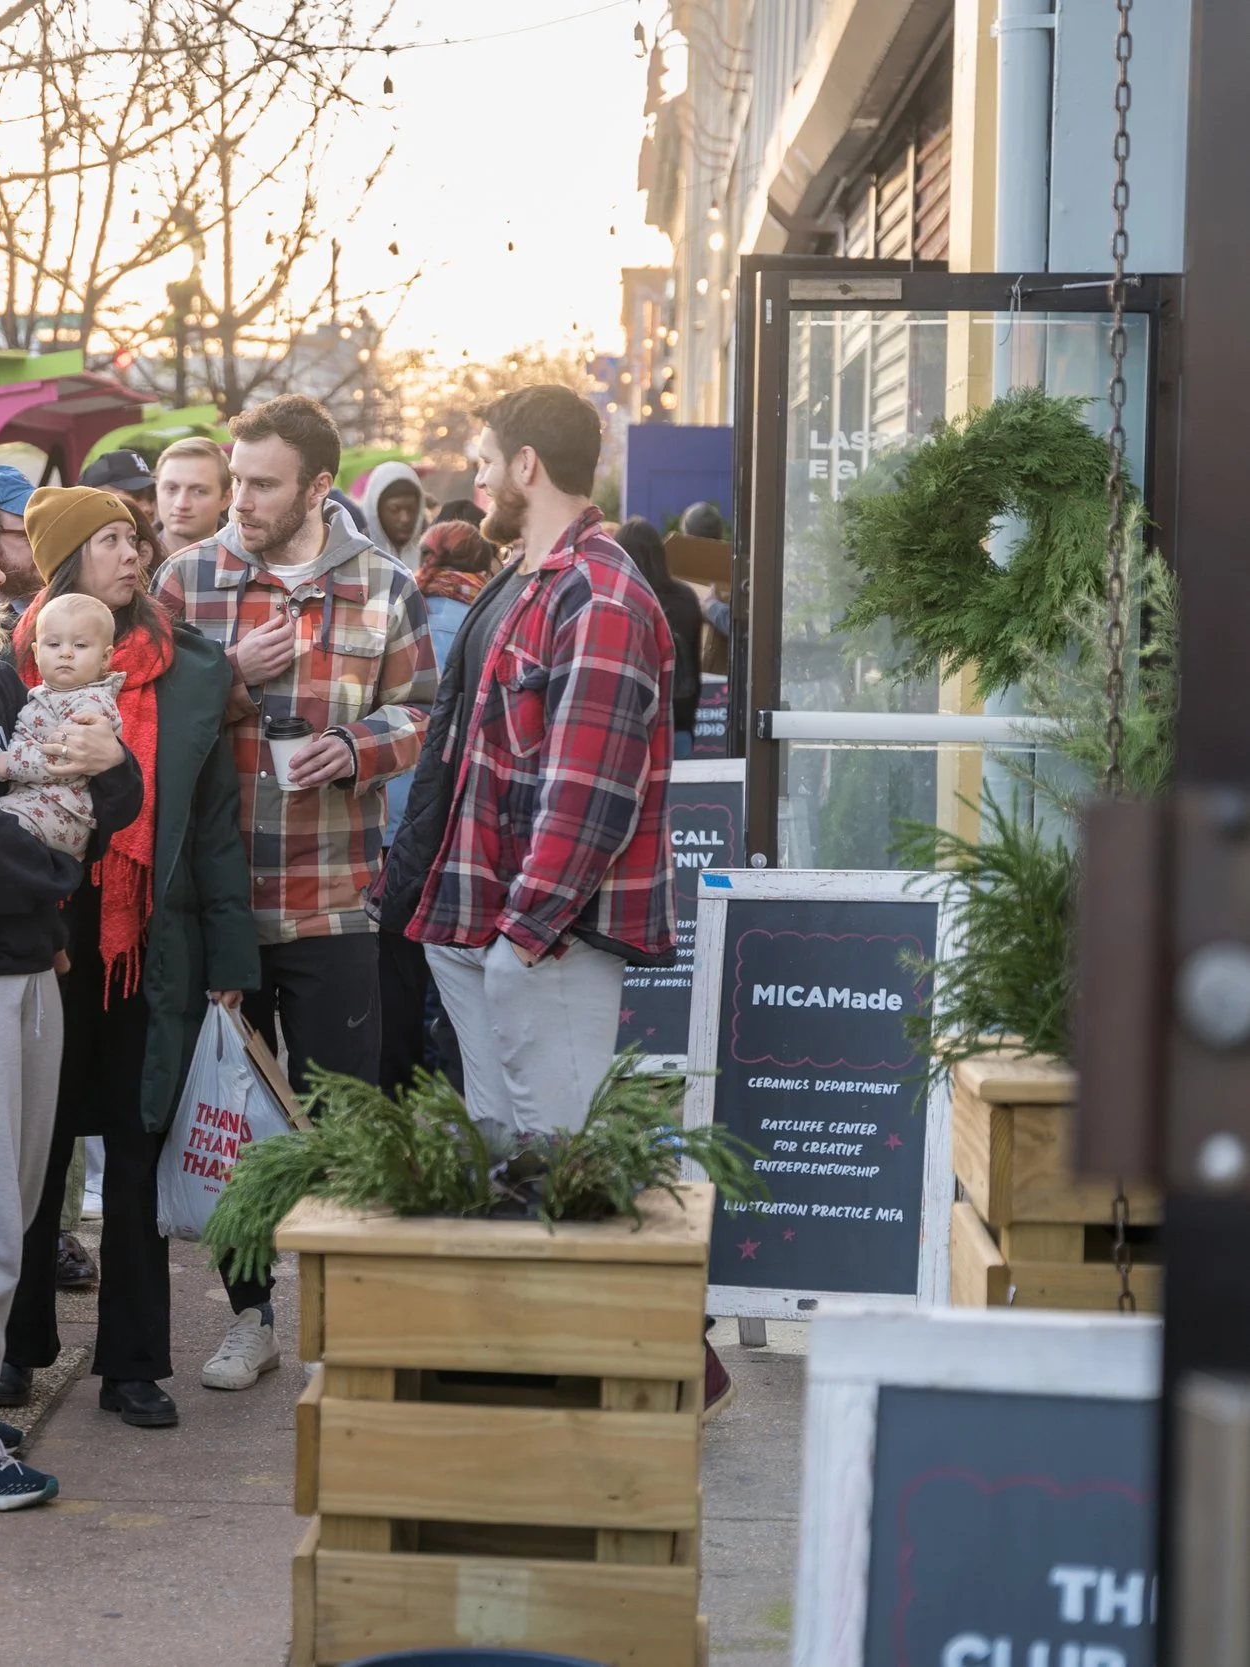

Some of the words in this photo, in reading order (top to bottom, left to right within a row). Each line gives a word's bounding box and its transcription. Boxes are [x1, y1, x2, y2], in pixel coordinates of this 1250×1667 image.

[671, 830, 725, 846] CALL
[672, 852, 714, 868] NIV
[623, 978, 651, 988] JOSEF
[752, 984, 903, 1011] MICAMade
[748, 1077, 810, 1090] CERAMICS
[815, 1080, 901, 1095] DEPARTMENT
[761, 1118, 825, 1133] RATCLIFFE
[828, 1122, 878, 1136] CENTER
[773, 1140, 798, 1153] FOR
[802, 1142, 863, 1156] CREATIVE
[753, 1159, 880, 1178] ENTREPRENEURSHIP
[811, 1204, 873, 1220] PRACTICE
[875, 1207, 904, 1223] MFA
[1050, 1566, 1158, 1627] TH
